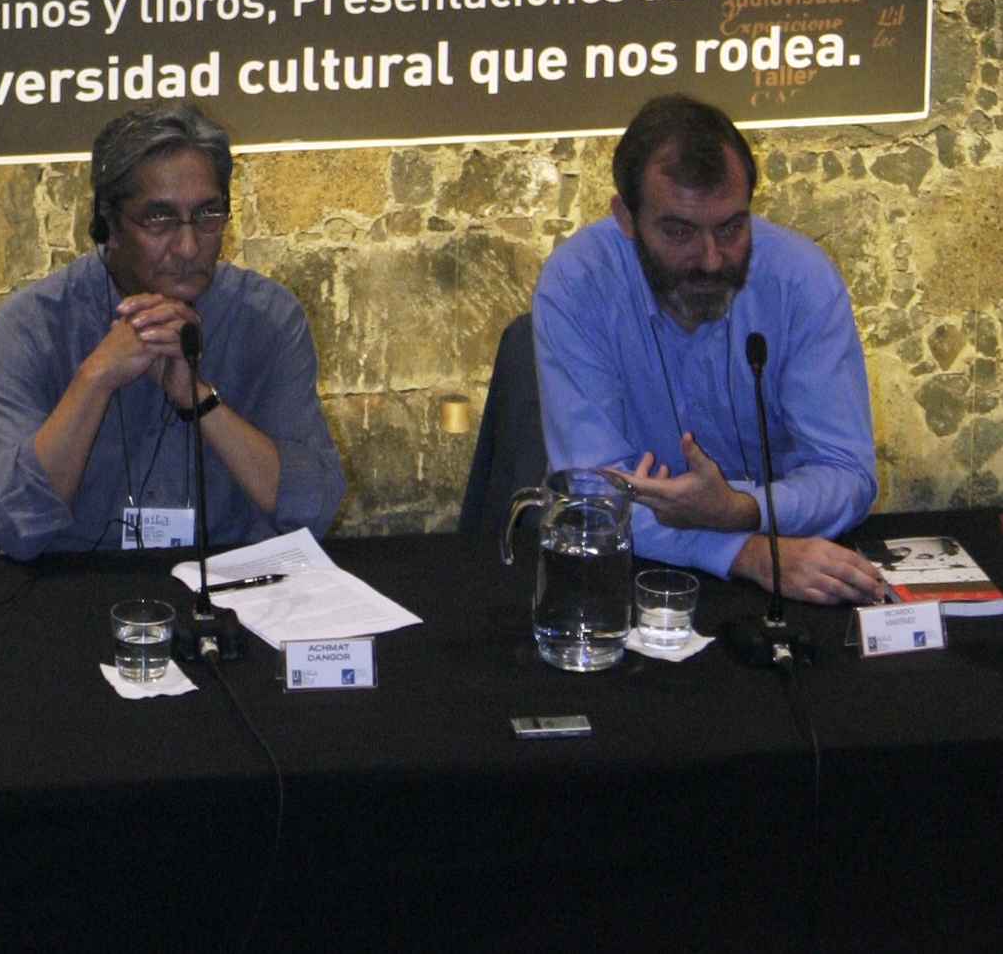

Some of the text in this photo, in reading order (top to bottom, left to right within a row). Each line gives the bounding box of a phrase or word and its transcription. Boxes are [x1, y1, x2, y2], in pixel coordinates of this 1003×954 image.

[238, 40, 454, 95] cultural
[470, 45, 568, 94] que
[585, 39, 678, 80] nos
[695, 25, 861, 74] rodea.
[308, 644, 350, 652] ACHMAT
[308, 653, 351, 662] DANGOR
